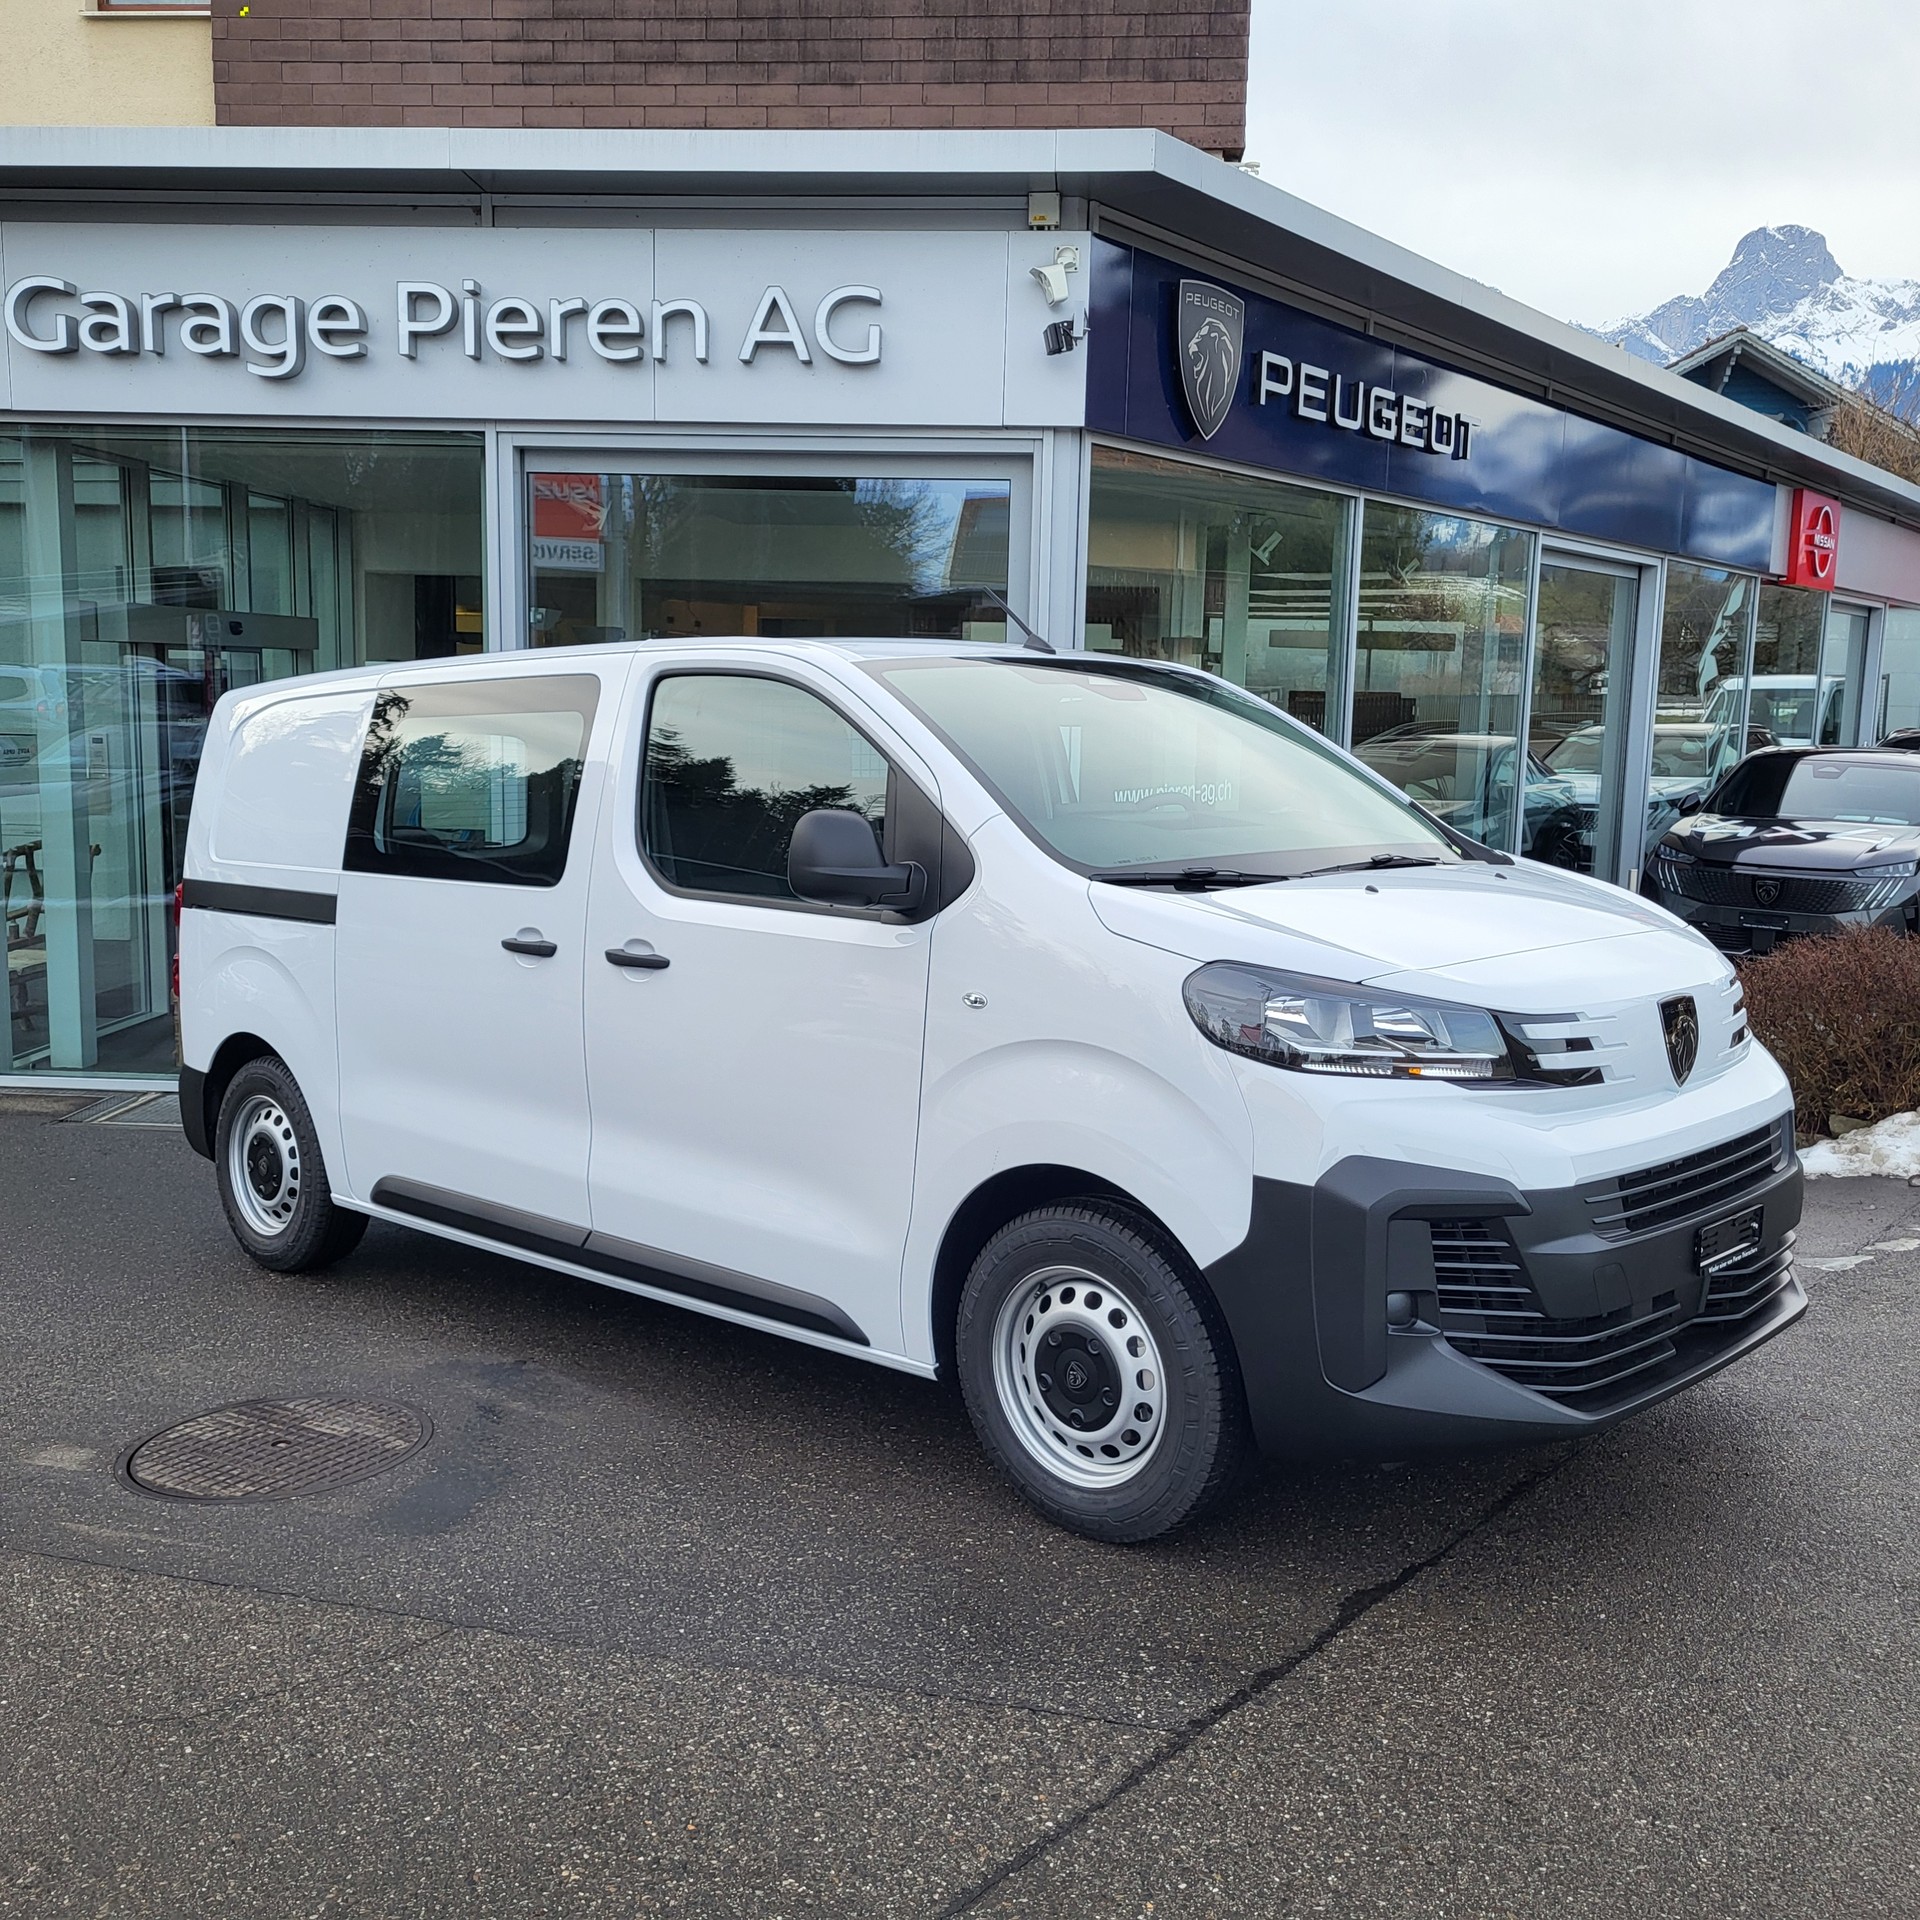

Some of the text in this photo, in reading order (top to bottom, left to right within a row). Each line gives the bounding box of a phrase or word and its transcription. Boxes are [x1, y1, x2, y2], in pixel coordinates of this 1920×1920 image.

[3, 274, 883, 379] Garage Pieren AG
[1185, 292, 1240, 320] PEUGEOT
[1258, 350, 1482, 460] PEUGEOT
[1814, 533, 1836, 550] NISSAN
